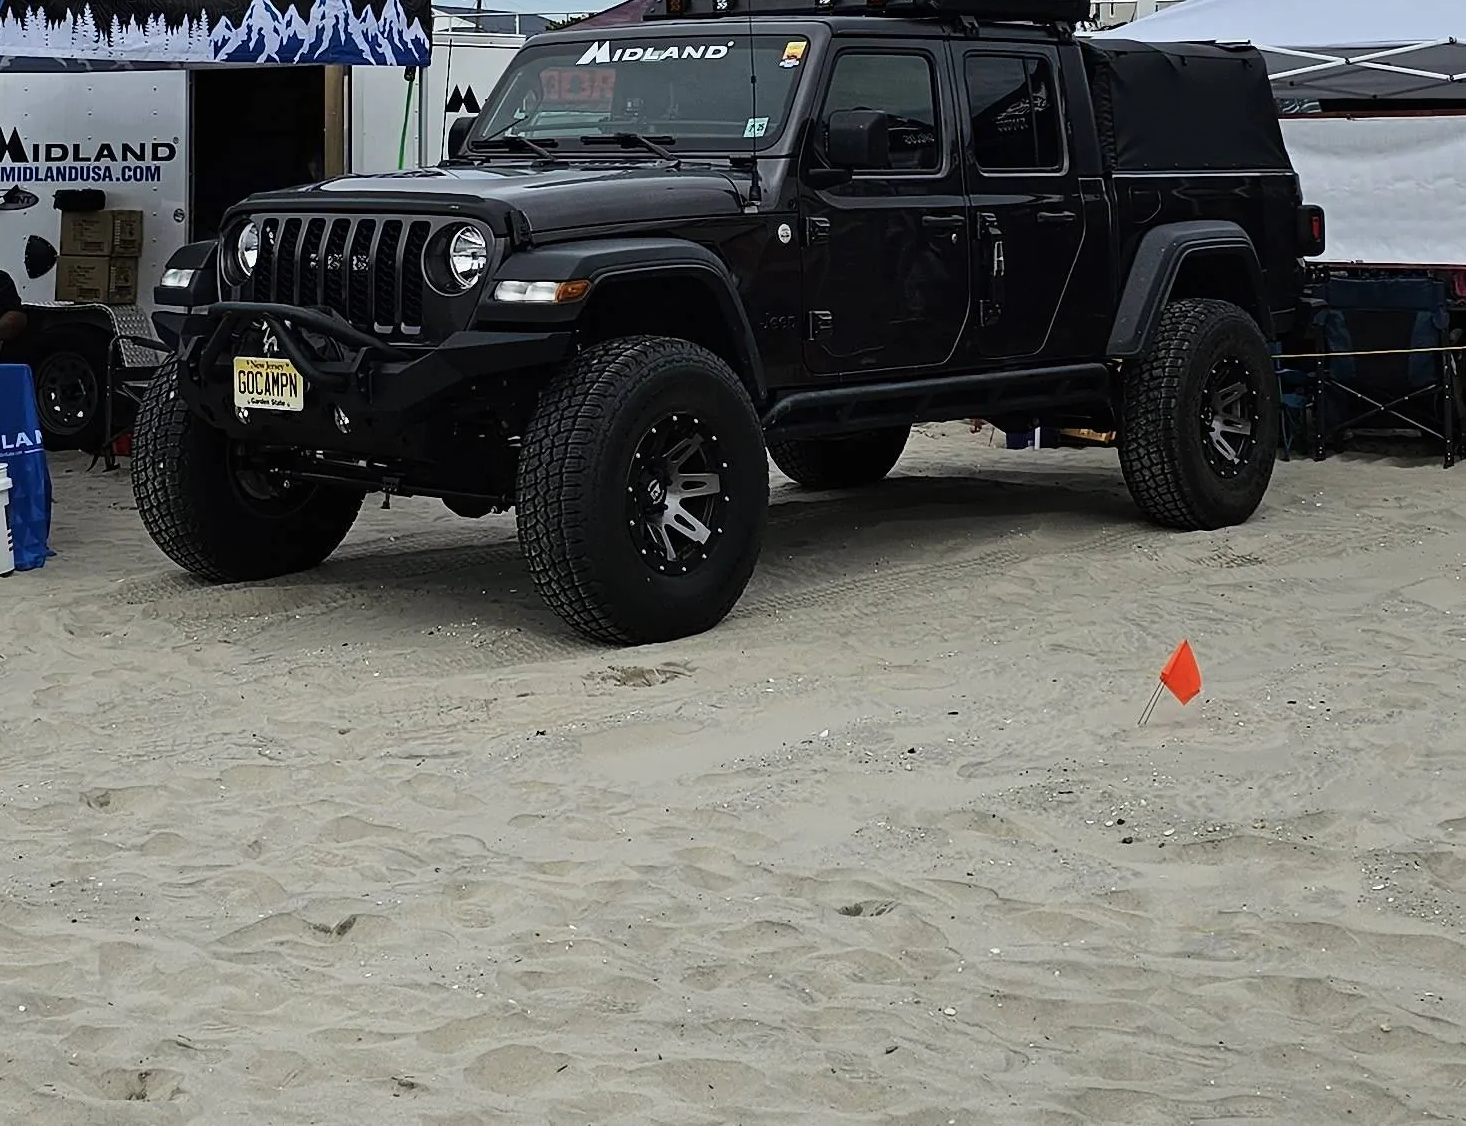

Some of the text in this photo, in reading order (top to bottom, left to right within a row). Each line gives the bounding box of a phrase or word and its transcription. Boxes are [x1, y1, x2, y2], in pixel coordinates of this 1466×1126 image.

[575, 40, 726, 65] MIDLAND
[0, 165, 161, 182] MIDLANDUSA.COM
[250, 360, 284, 371] New Jersey
[238, 370, 298, 398] GOCAMPN
